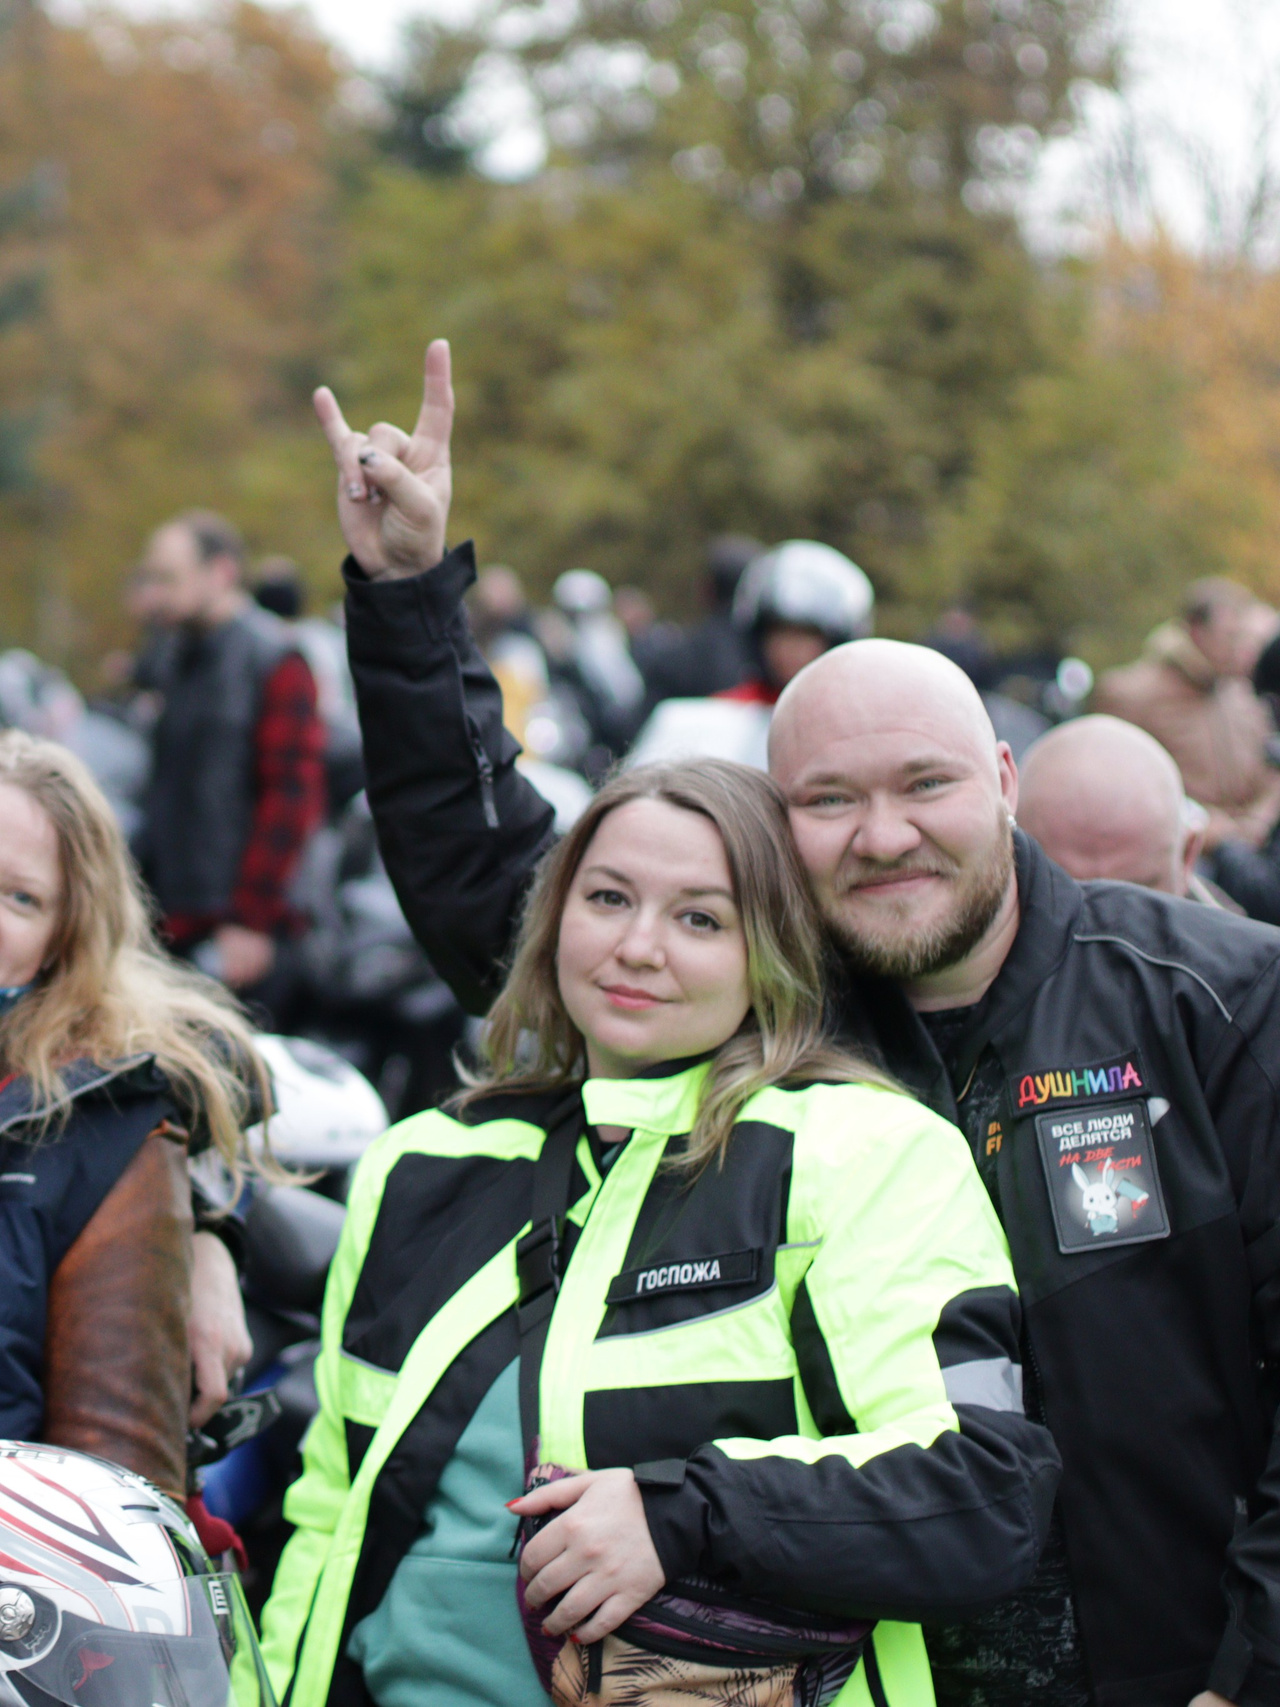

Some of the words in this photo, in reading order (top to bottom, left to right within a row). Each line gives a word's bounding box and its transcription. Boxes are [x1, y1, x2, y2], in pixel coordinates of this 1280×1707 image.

[1018, 1061, 1143, 1108] ДУШНИЛА
[1051, 1121, 1084, 1139] ВСЕ
[1087, 1112, 1135, 1133] ЛЮДИ
[1059, 1126, 1132, 1152] ДЕЛЯТСЯ
[1059, 1152, 1081, 1168] НА
[1083, 1146, 1115, 1163] ДВЕ
[636, 1259, 721, 1294] ГОСПОЖА
